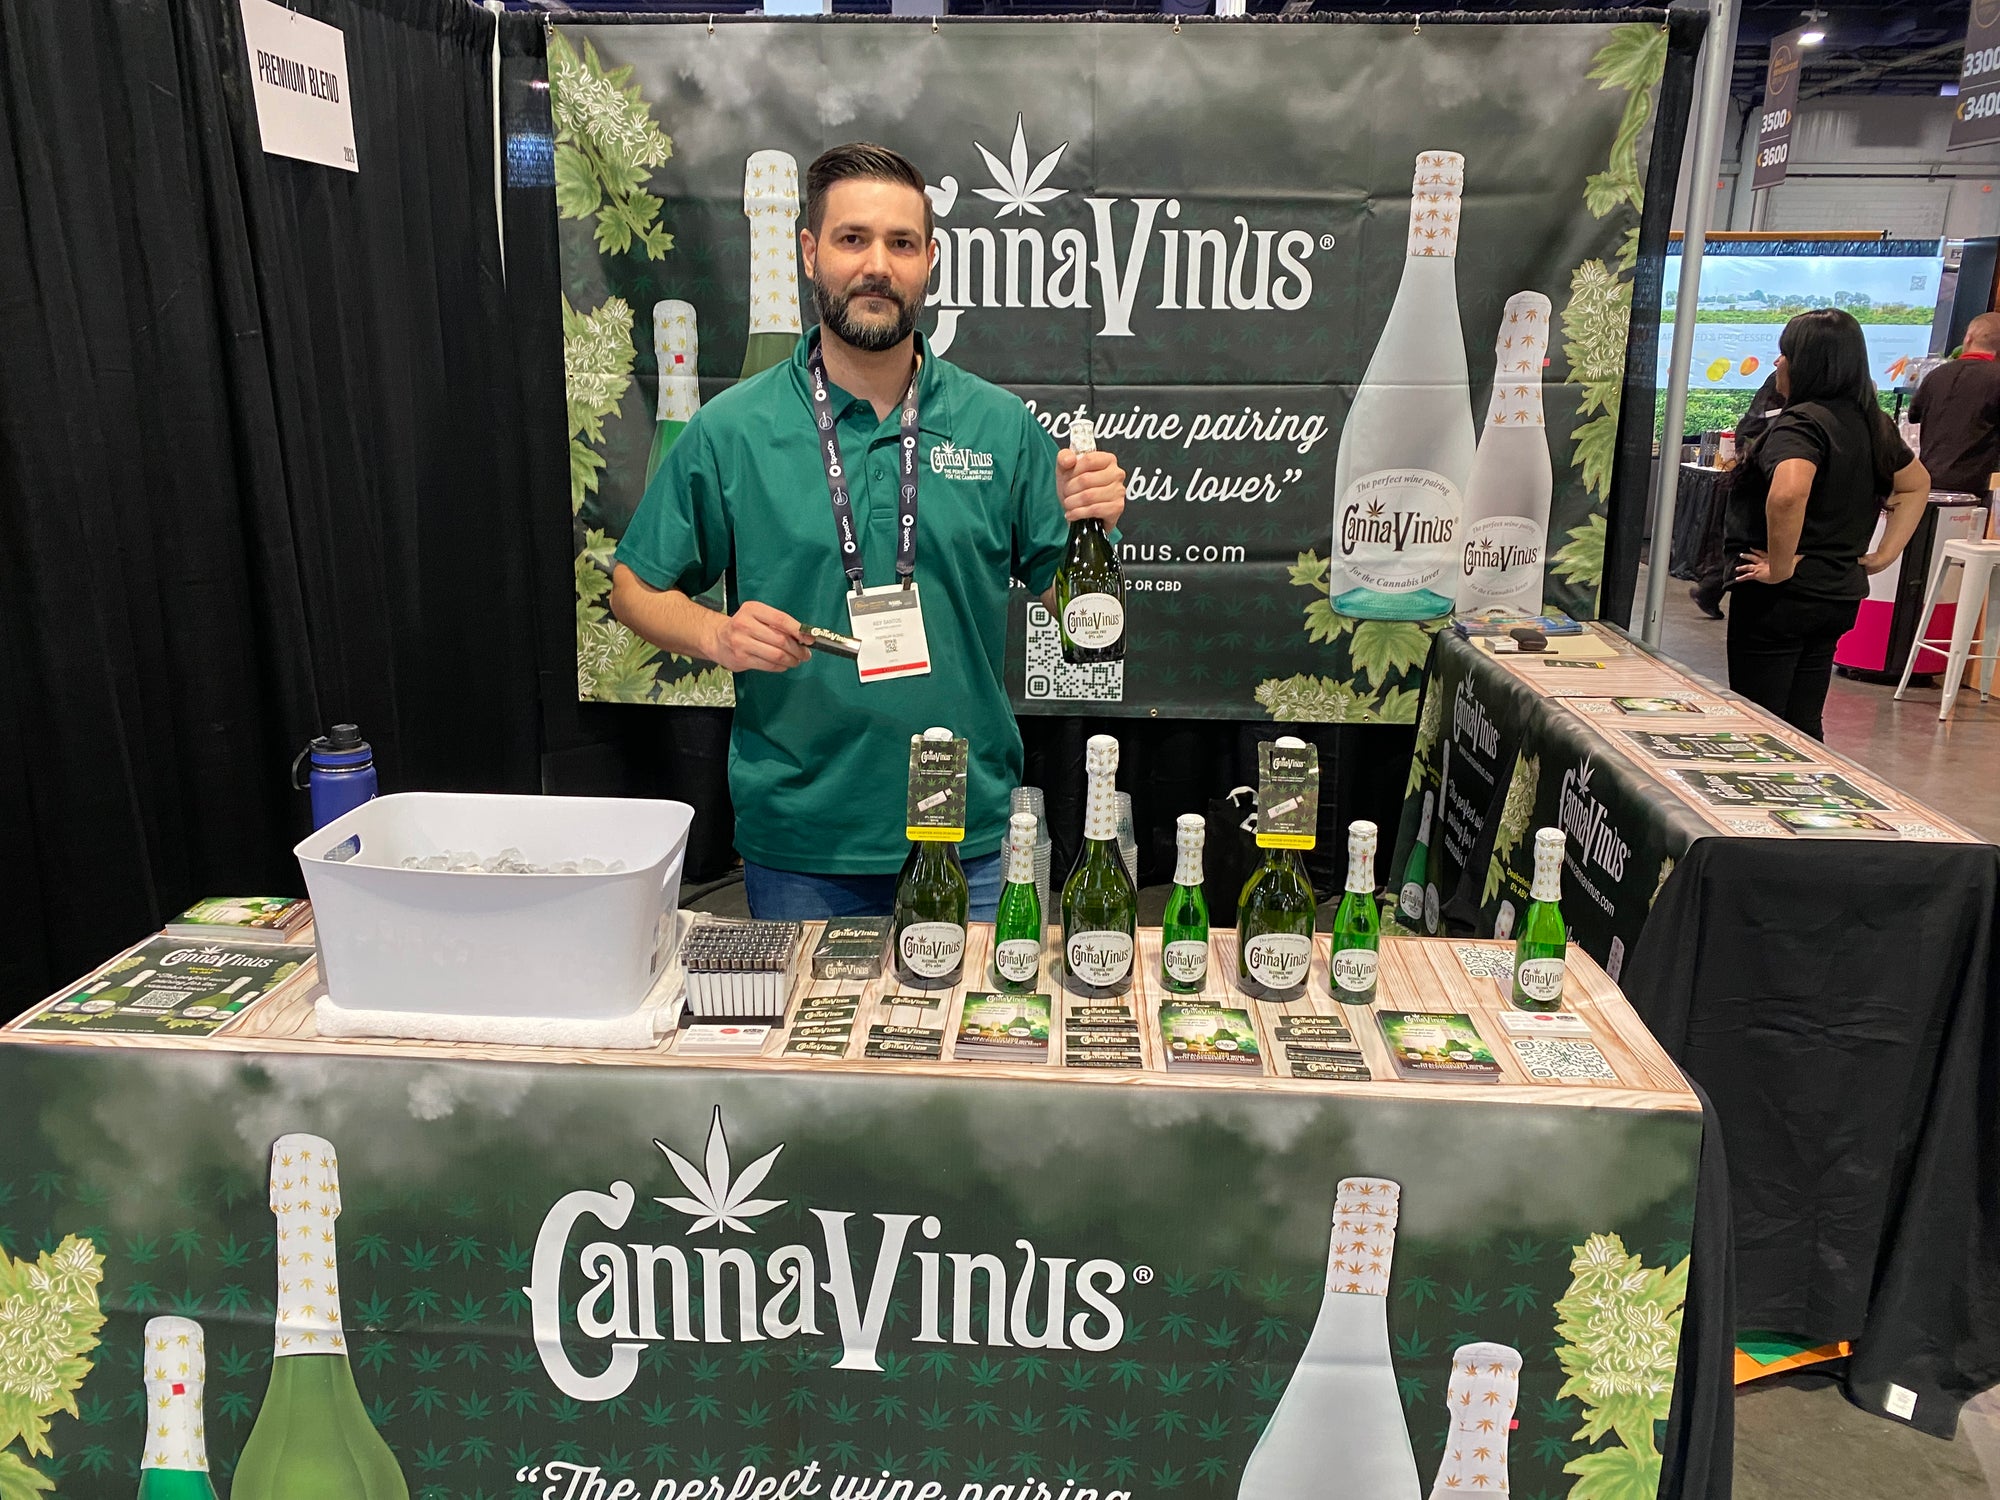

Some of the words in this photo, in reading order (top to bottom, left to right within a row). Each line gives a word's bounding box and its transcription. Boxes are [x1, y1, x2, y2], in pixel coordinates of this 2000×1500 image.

[257, 49, 307, 94] PREMIUM
[308, 66, 339, 104] BLEND
[1761, 108, 1787, 134] 3500
[1762, 143, 1787, 167] 3600
[1093, 405, 1183, 440] wine
[1183, 405, 1329, 454] pairing
[930, 446, 993, 473] CannaVinus
[1185, 466, 1303, 503] lover”
[1356, 480, 1371, 493] The
[1372, 475, 1403, 489] perfect
[1404, 474, 1424, 484] wine
[1422, 479, 1450, 497] pairing
[1135, 580, 1153, 591] OR
[1155, 580, 1182, 592] CBD
[1361, 573, 1375, 583] the
[1376, 577, 1419, 588] Cannabis
[1421, 567, 1440, 582] lover
[160, 949, 274, 969] CannaVinus
[1250, 946, 1308, 969] CannaVinus
[650, 1459, 821, 1500] perfect
[829, 1470, 948, 1500] wine
[958, 1476, 1132, 1500] pairin
